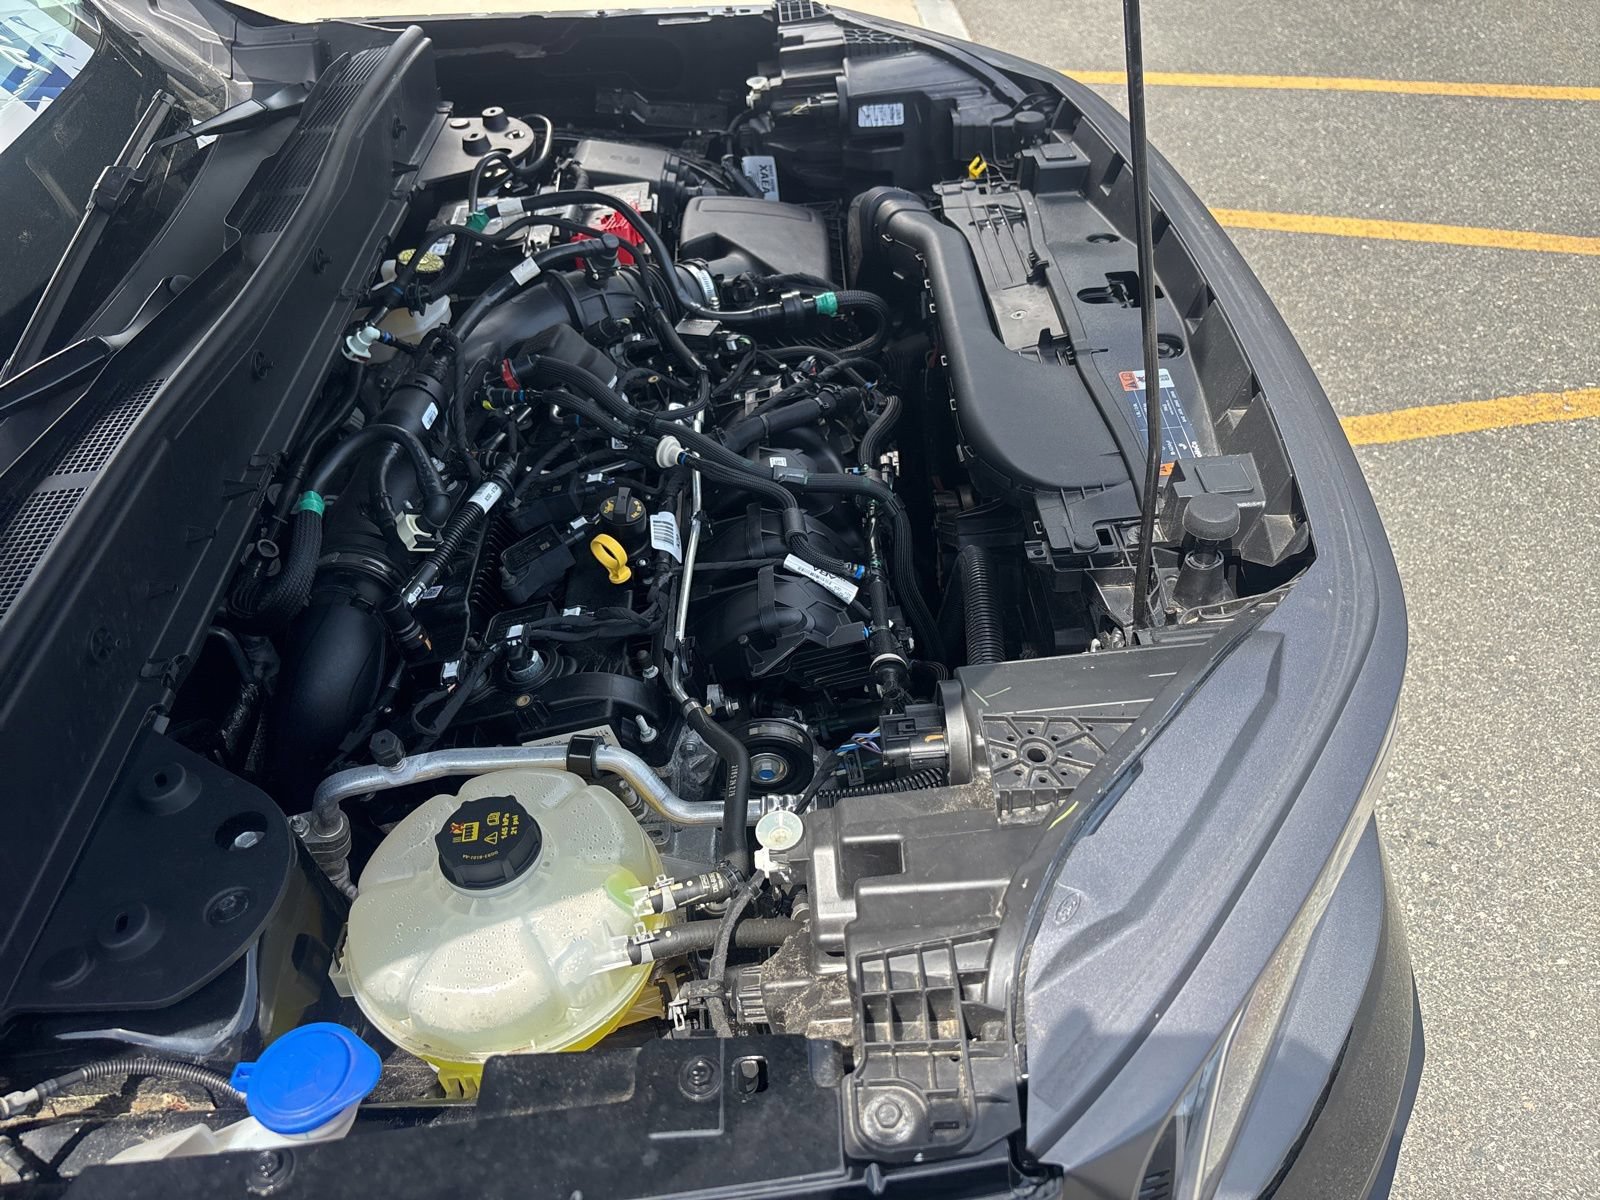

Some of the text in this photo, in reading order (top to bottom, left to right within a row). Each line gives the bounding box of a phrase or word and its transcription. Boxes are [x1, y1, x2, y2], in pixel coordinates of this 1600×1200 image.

[500, 812, 510, 840] 145 kPa
[510, 814, 519, 835] 21 psi
